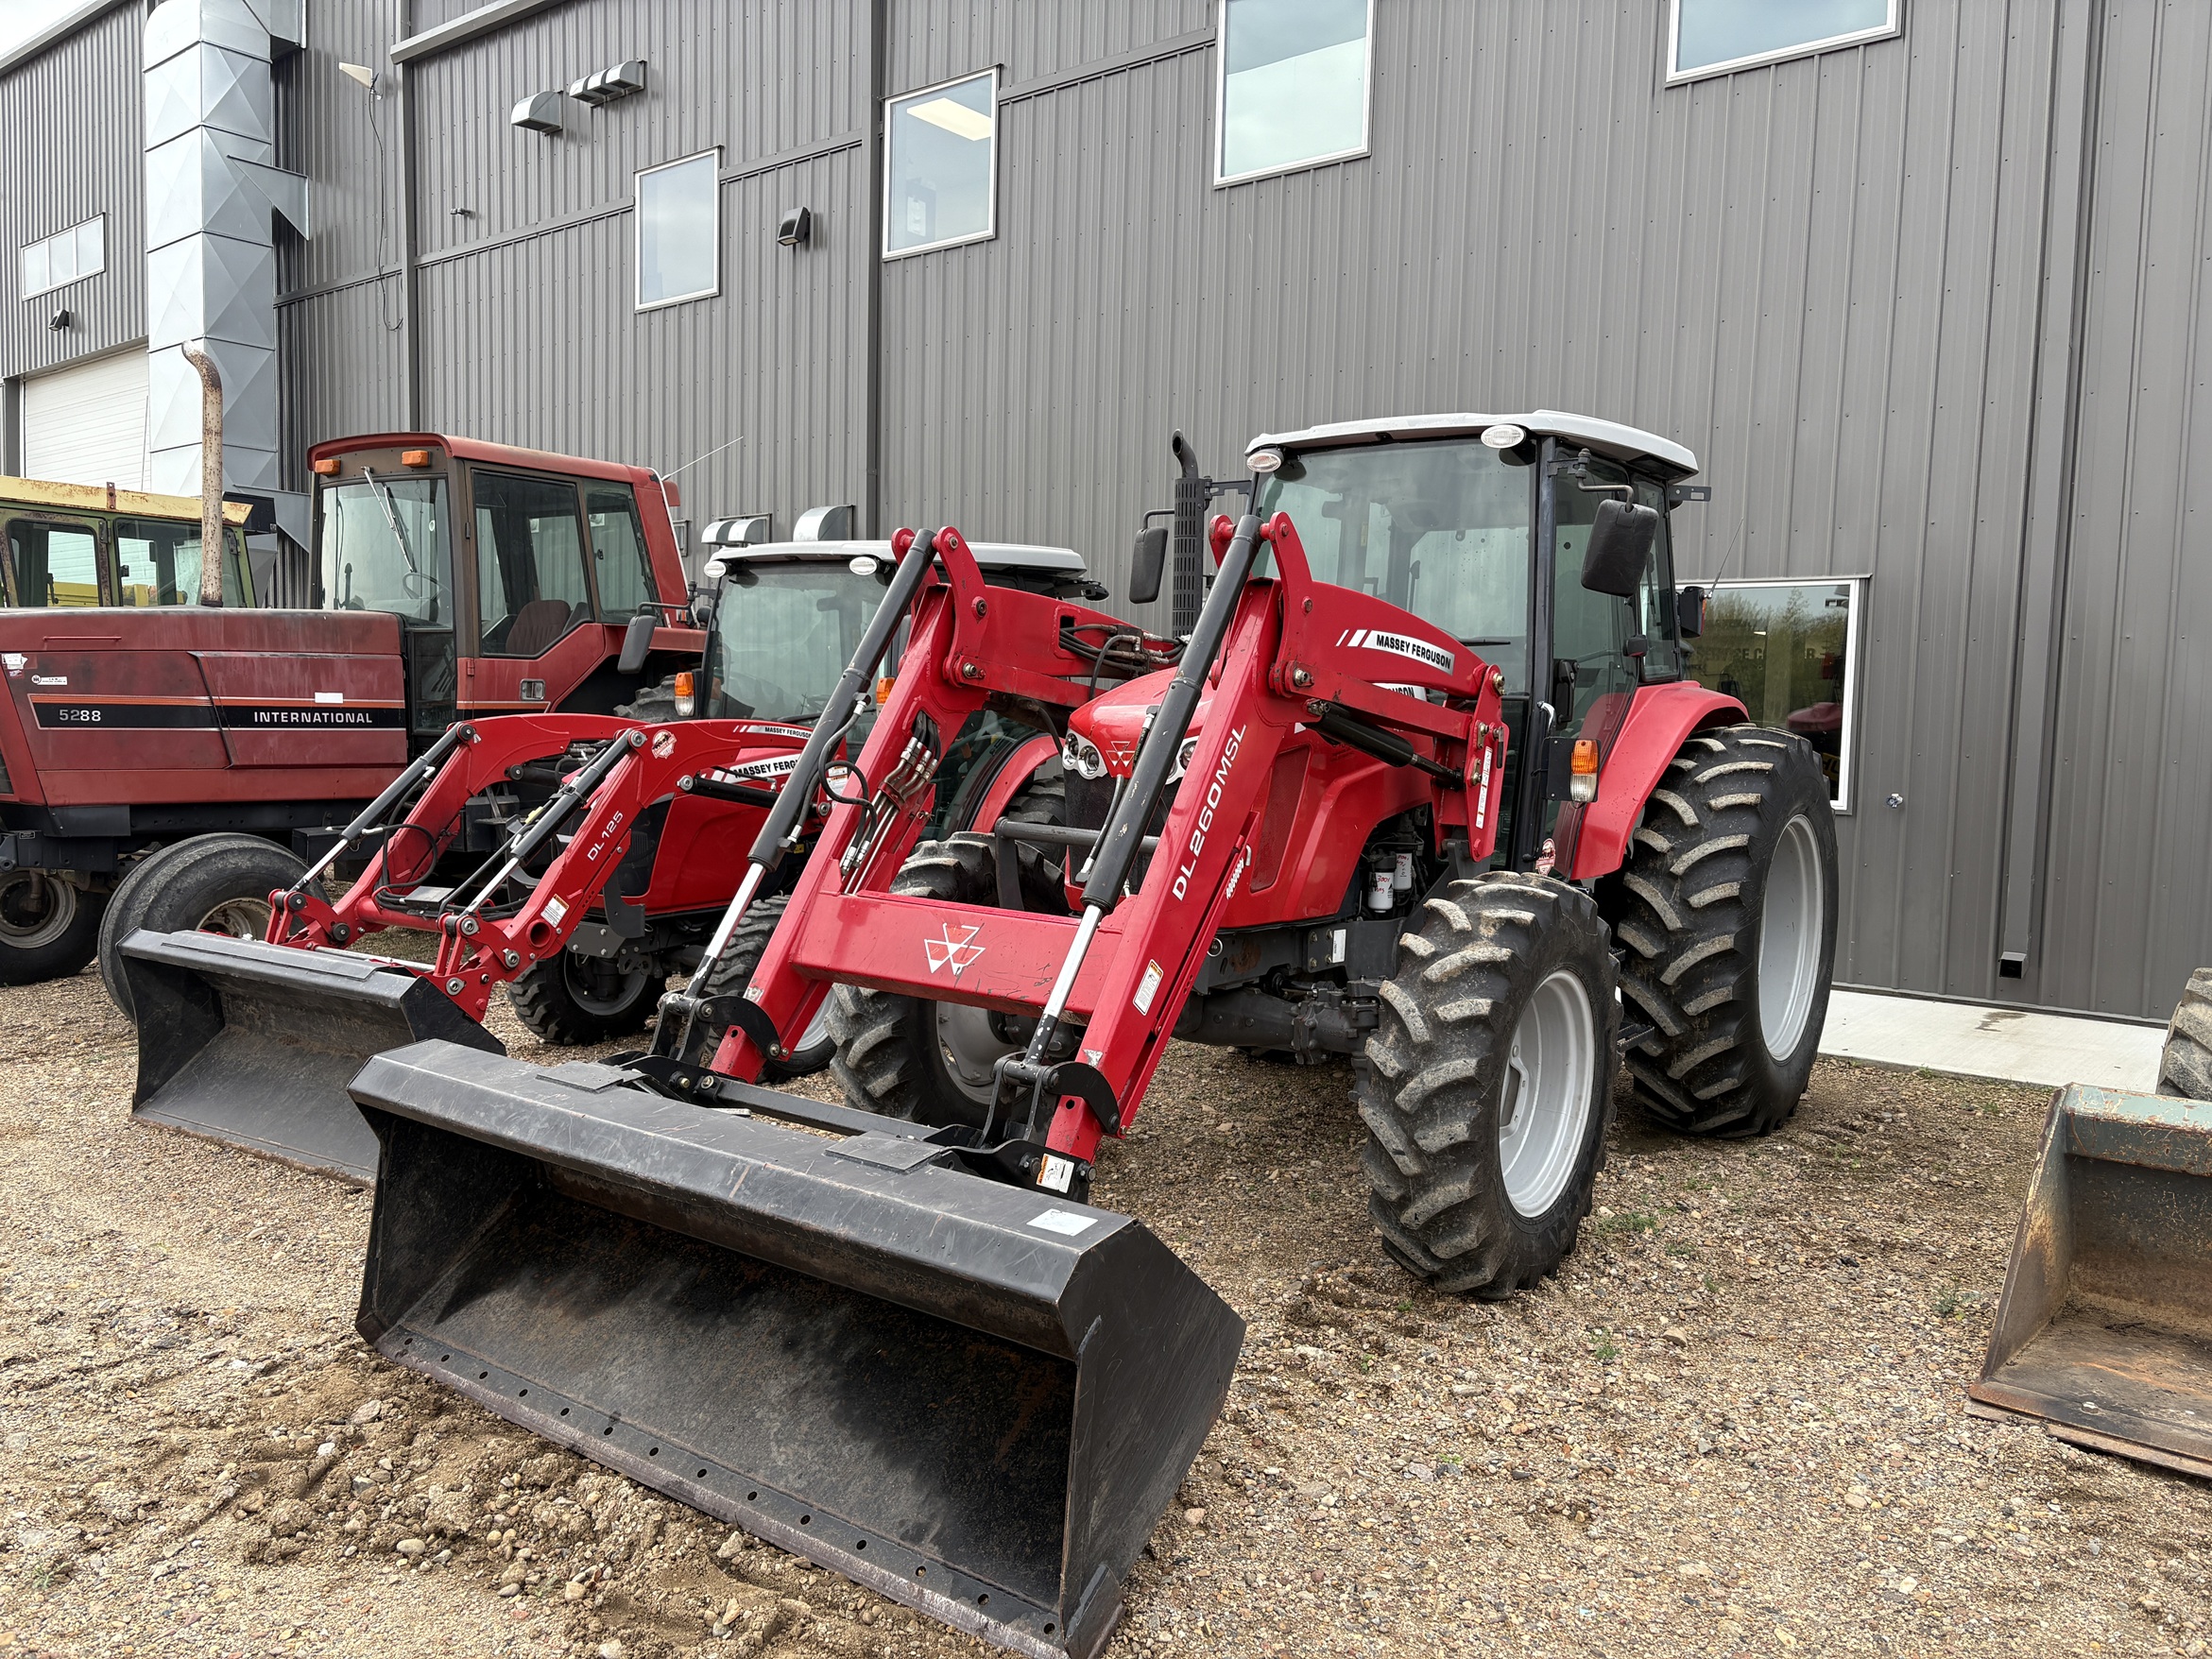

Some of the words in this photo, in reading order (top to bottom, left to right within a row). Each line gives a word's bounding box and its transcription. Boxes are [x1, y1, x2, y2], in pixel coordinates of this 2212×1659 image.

[1376, 634, 1411, 654] MASSEY
[1411, 643, 1451, 670] FERGUSON
[59, 709, 101, 722] 5288
[253, 711, 373, 724] INTERNATIONAL
[773, 759, 798, 772] FERG
[1172, 724, 1247, 901] DL260MSL
